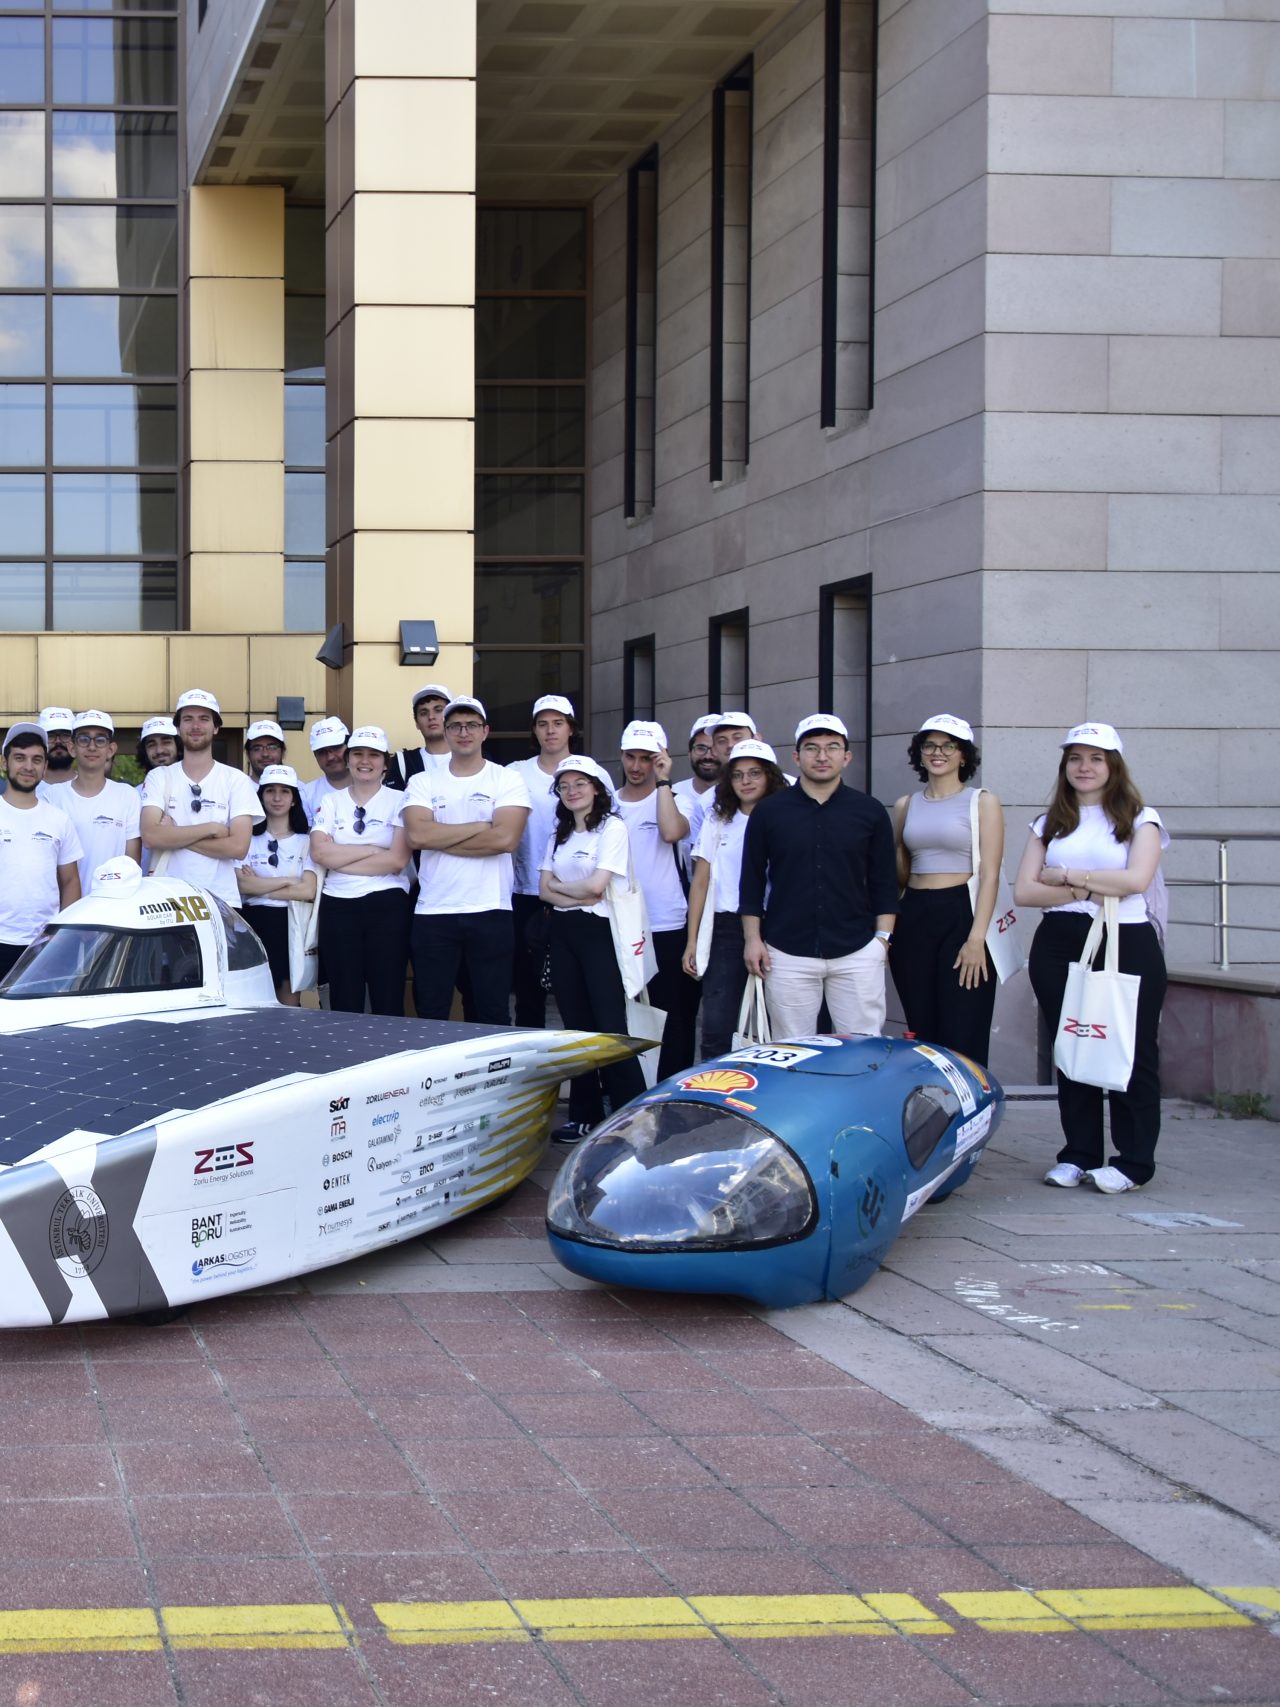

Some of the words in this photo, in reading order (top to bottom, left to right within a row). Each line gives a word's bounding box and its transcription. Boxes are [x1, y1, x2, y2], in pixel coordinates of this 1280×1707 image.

[100, 872, 121, 881] ZES
[1063, 1018, 1107, 1040] ZES
[194, 1141, 254, 1174] ZES
[332, 1149, 353, 1163] BOSCH
[193, 1178, 209, 1186] Zorlu
[209, 1174, 229, 1183] Energy
[229, 1168, 254, 1180] Solutions
[331, 1174, 351, 1188] ENTEK
[323, 1202, 338, 1214] GAMA
[192, 1213, 223, 1231] BANT
[192, 1226, 223, 1248] BORU
